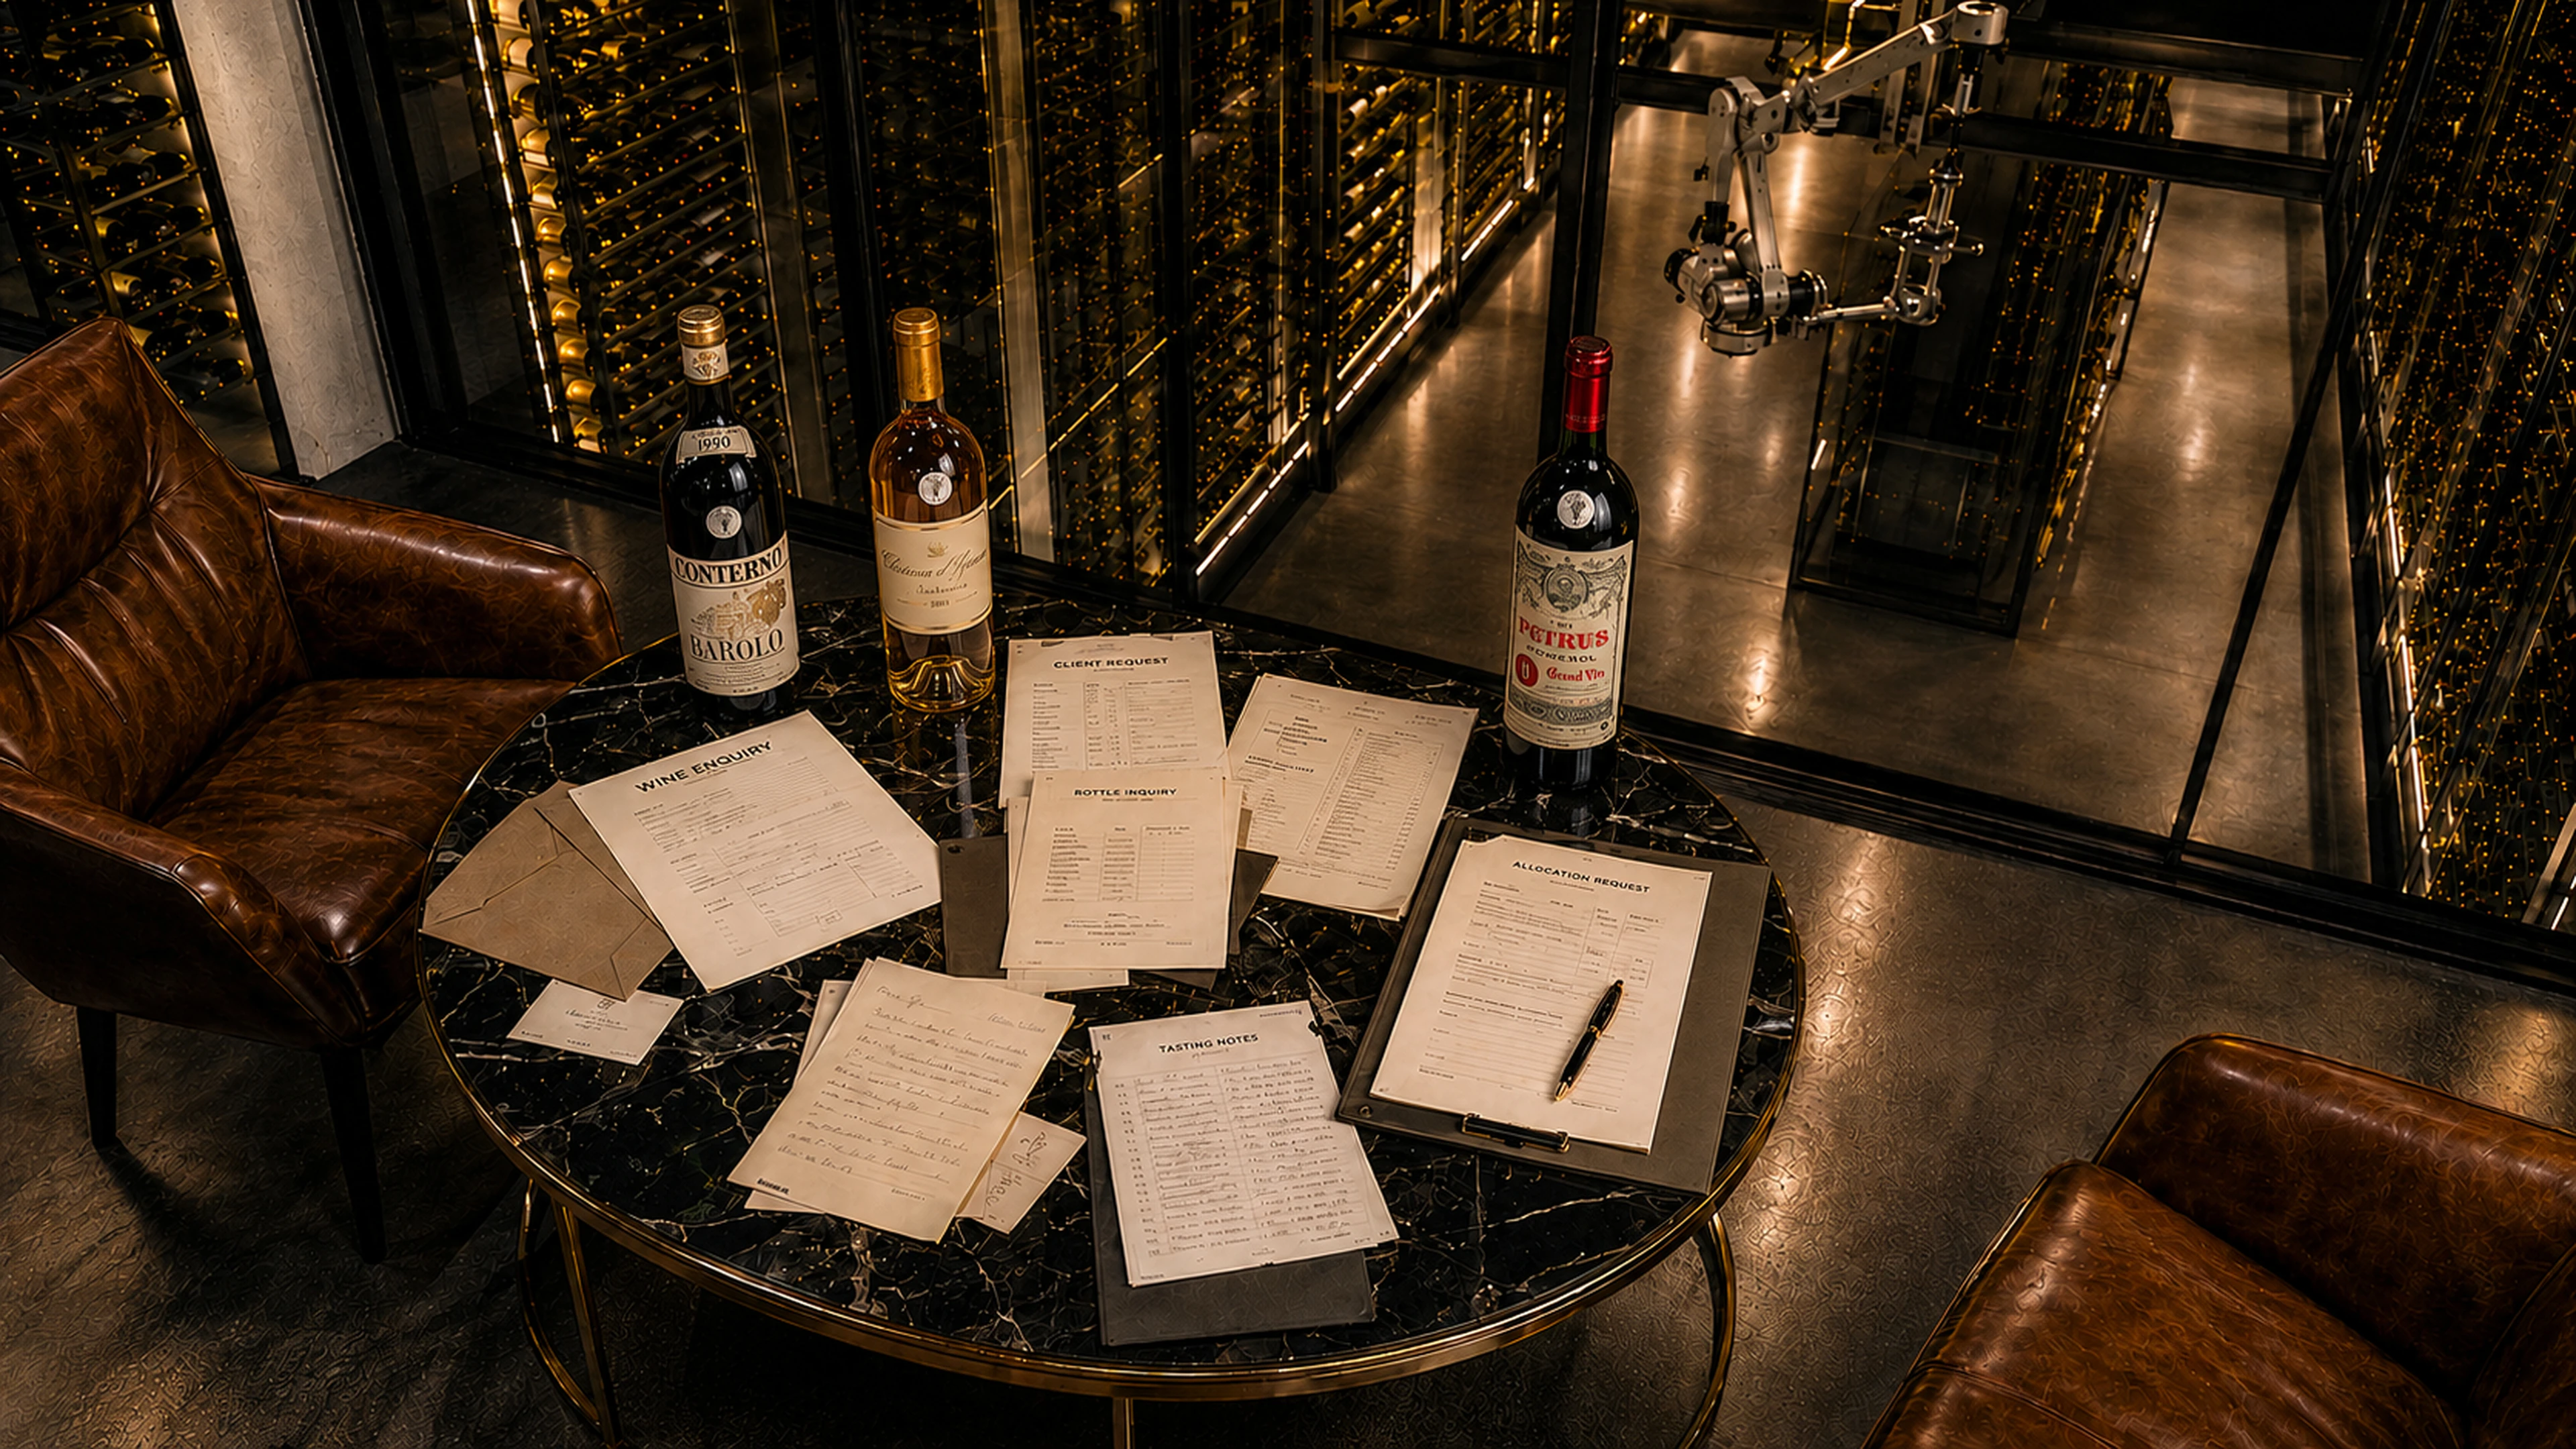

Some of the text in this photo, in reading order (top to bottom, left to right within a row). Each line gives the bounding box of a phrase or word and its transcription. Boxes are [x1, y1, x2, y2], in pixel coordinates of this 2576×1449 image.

[698, 435, 731, 451] 1990
[675, 547, 782, 584] CONTERNO
[690, 628, 784, 661] BAROLO
[1519, 615, 1609, 650] PETRUS
[1053, 657, 1169, 669] CLIENT REQUEST
[635, 741, 772, 793] WINE ENQUIRY
[1124, 788, 1177, 796] INQUIRY
[1512, 861, 1651, 894] ALLOCATION REQUEST
[1159, 1033, 1259, 1053] TASTING NOTES
